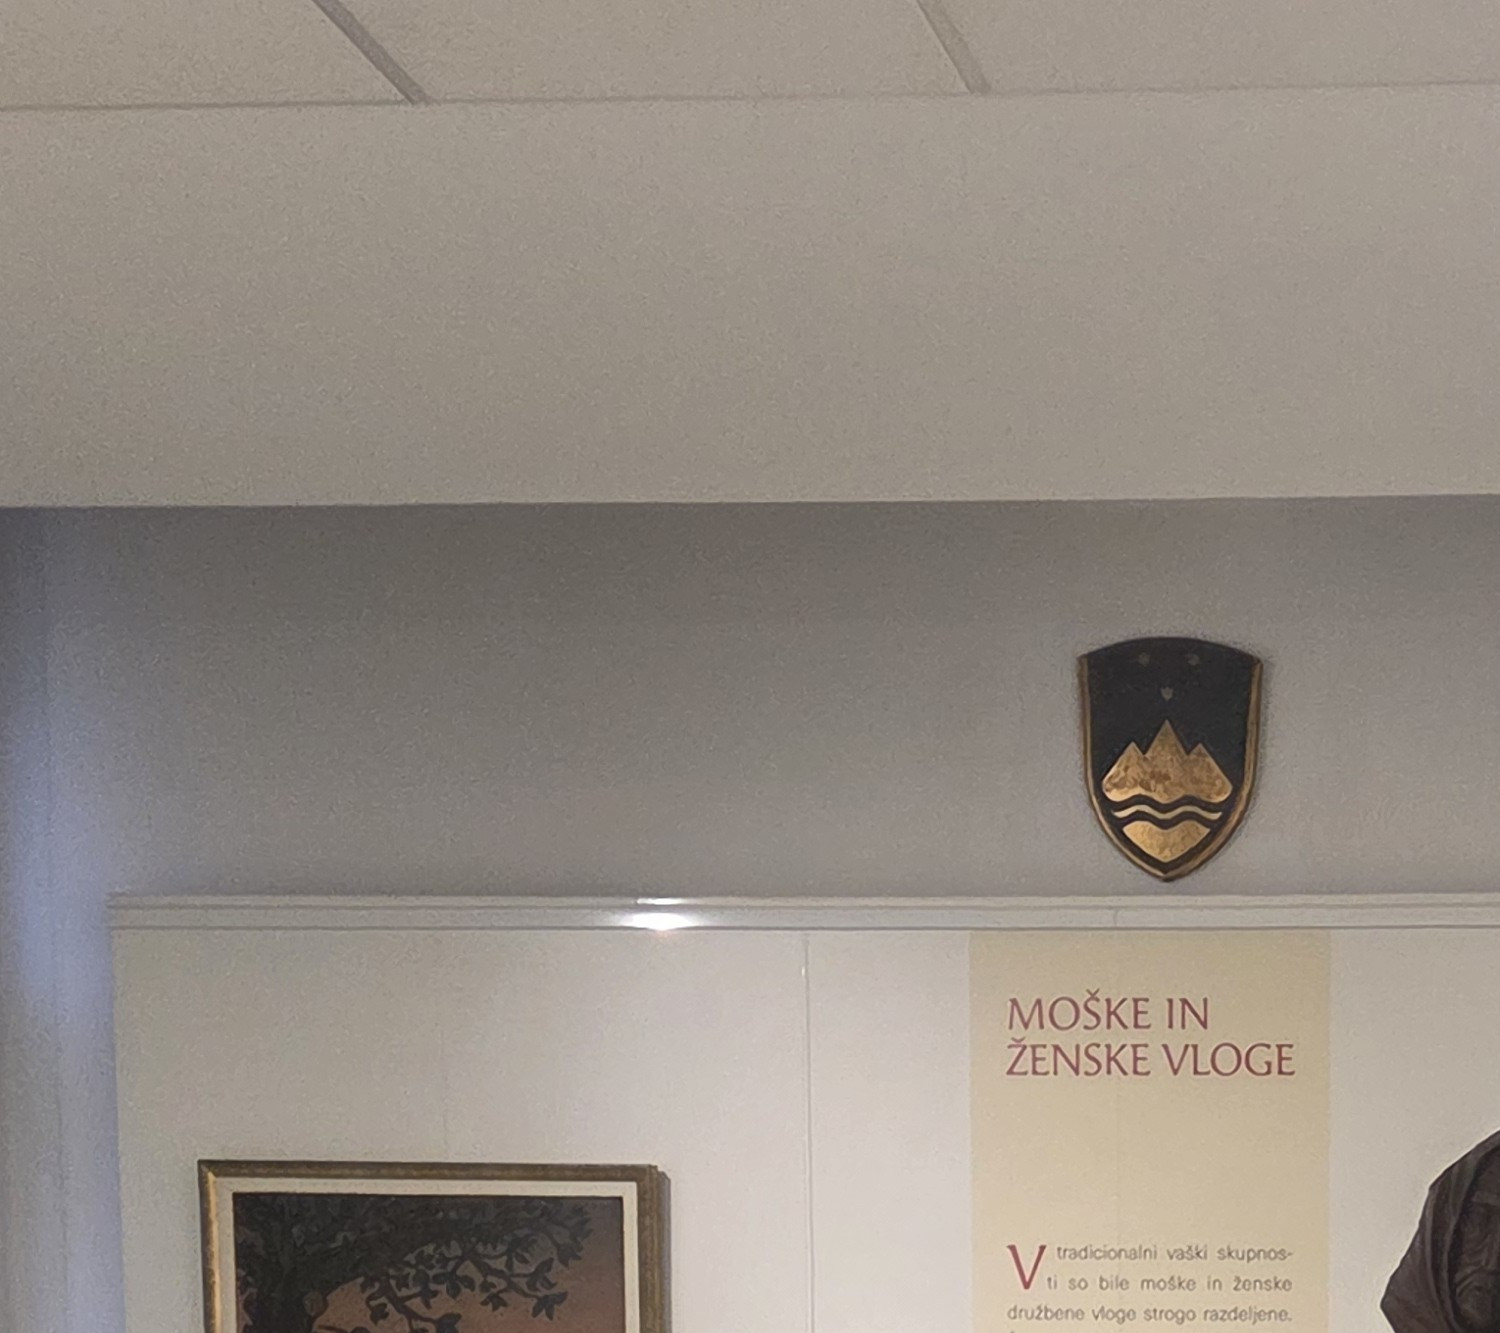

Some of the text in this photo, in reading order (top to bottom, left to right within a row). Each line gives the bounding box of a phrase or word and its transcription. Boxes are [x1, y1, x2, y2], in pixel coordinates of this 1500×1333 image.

[1007, 988, 1209, 1031] MOŠKE IN
[1006, 1037, 1296, 1076] ŽENSKE VLOGE
[1007, 1244, 1047, 1290] V
[1166, 1245, 1208, 1261] vaški
[1046, 1275, 1293, 1291] ti so bile moške in ženske
[1007, 1305, 1084, 1321] družbene
[1091, 1305, 1136, 1326] vloge
[1143, 1306, 1196, 1326] strogo
